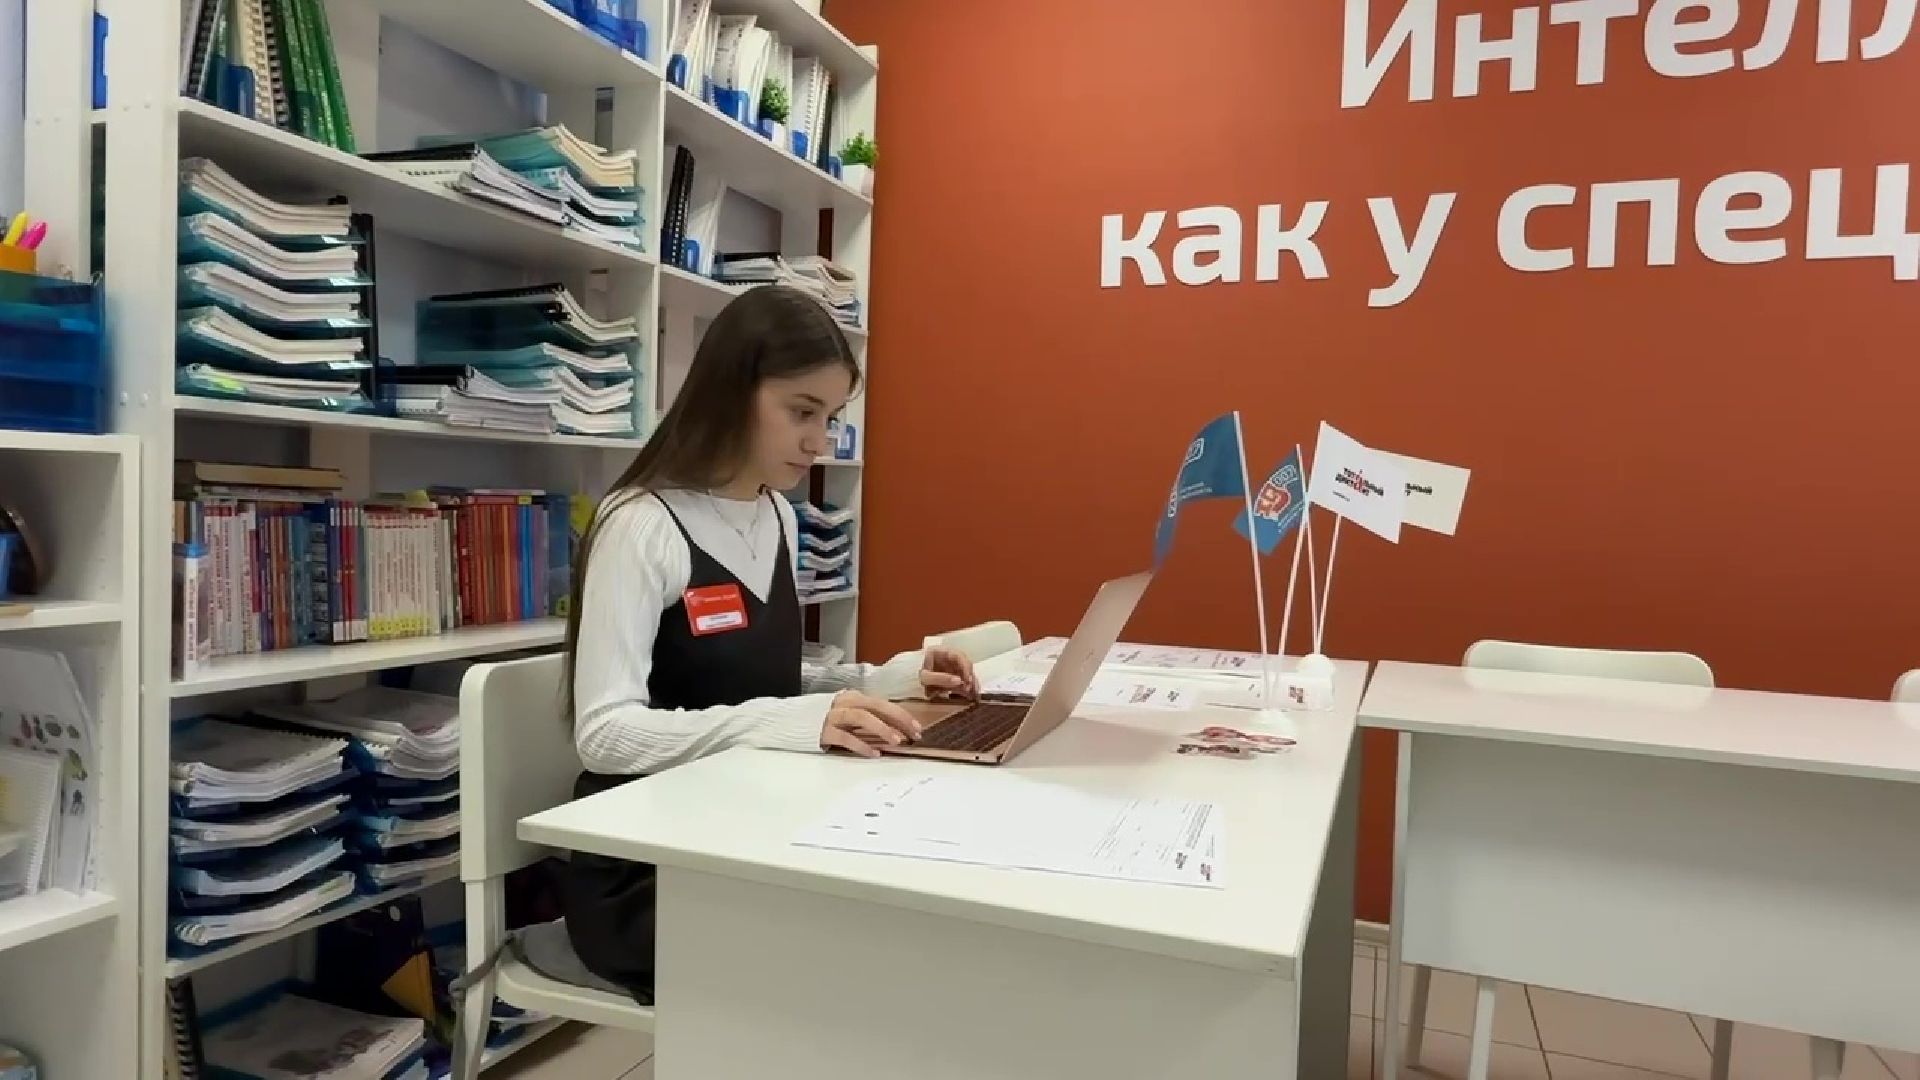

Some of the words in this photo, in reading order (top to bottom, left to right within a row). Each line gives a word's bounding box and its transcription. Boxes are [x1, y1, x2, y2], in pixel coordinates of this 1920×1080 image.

[1100, 201, 1329, 288] как
[1367, 192, 1457, 307] у
[1496, 163, 1920, 281] спец
